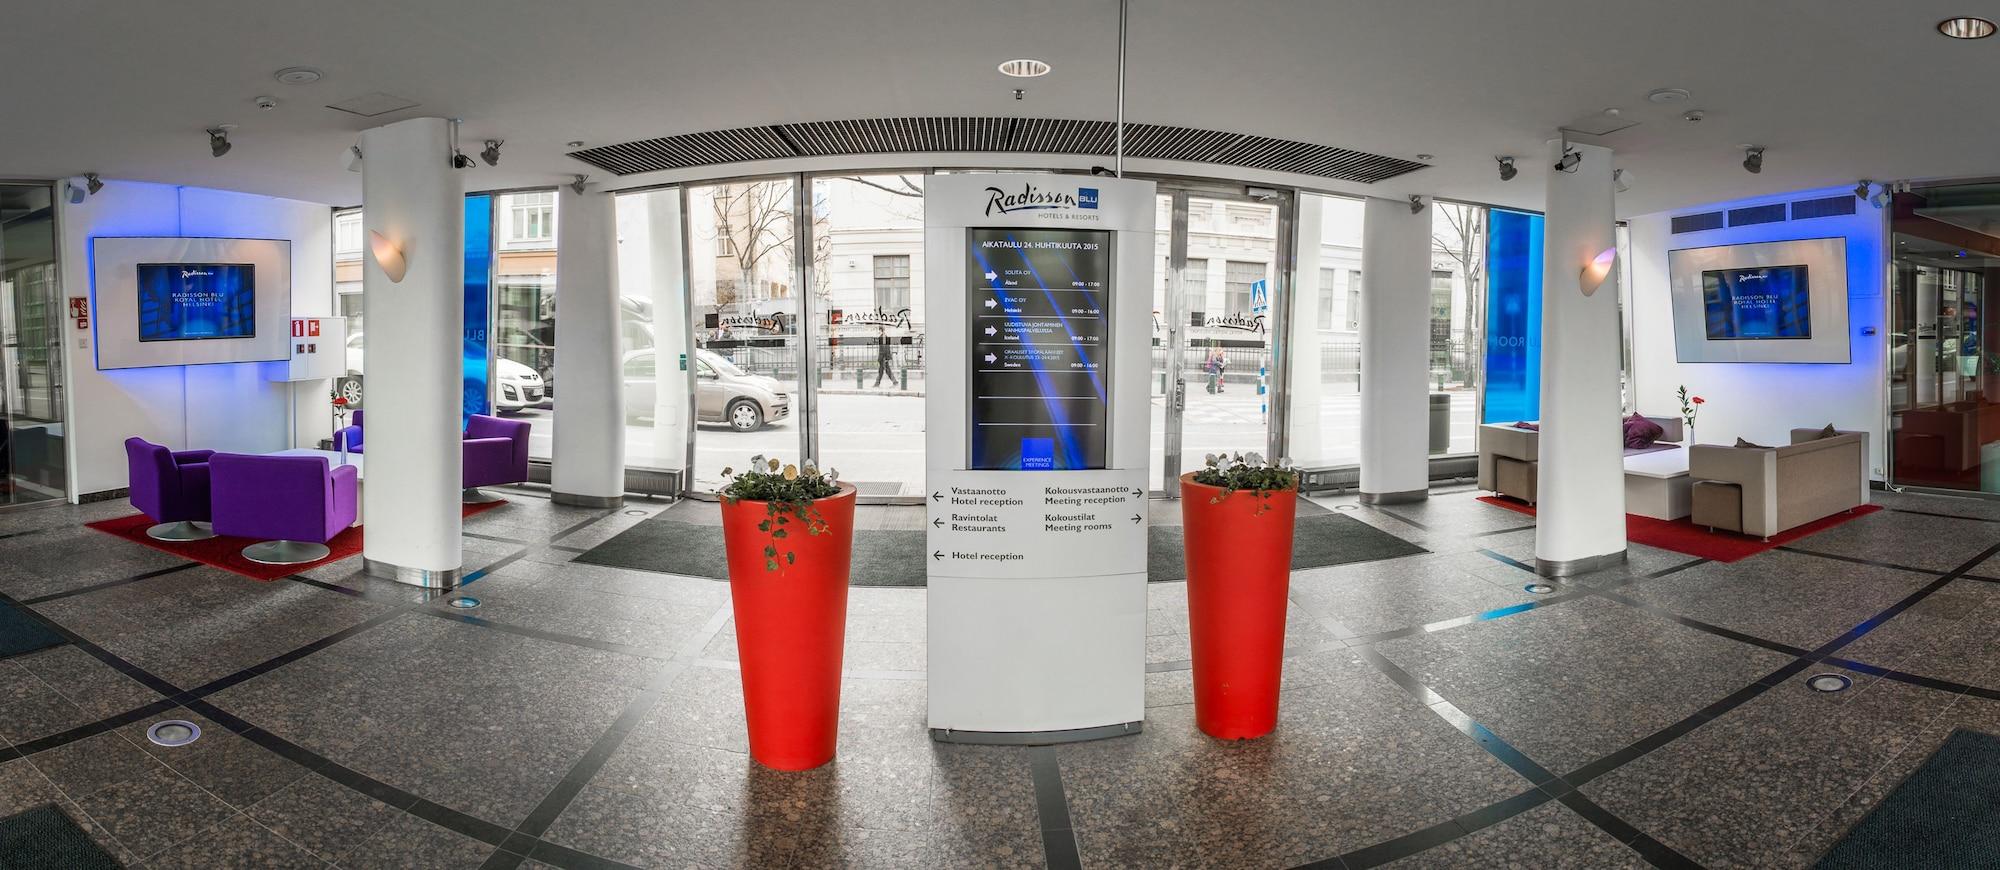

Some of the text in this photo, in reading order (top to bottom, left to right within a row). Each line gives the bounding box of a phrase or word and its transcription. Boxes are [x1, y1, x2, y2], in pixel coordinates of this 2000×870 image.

[985, 182, 1098, 217] Radisson BLU
[1072, 214, 1100, 222] RESORTS
[982, 240, 1023, 249] AIKATAULU
[1035, 241, 1082, 250] HUHTIKUUTA
[1083, 242, 1099, 250] 2015
[951, 487, 1006, 496] Vastaanotto
[1045, 486, 1129, 495] Kokousvastaanotto
[951, 497, 1023, 508] Hotel reception
[1045, 495, 1126, 507] Meeting reception
[951, 513, 998, 522] Ravintolat
[1045, 513, 1095, 522] Kokoustilat
[951, 524, 1006, 533] Restaurants
[1045, 523, 1112, 533] Meeting rooms
[952, 552, 1024, 562] Hotel reception
